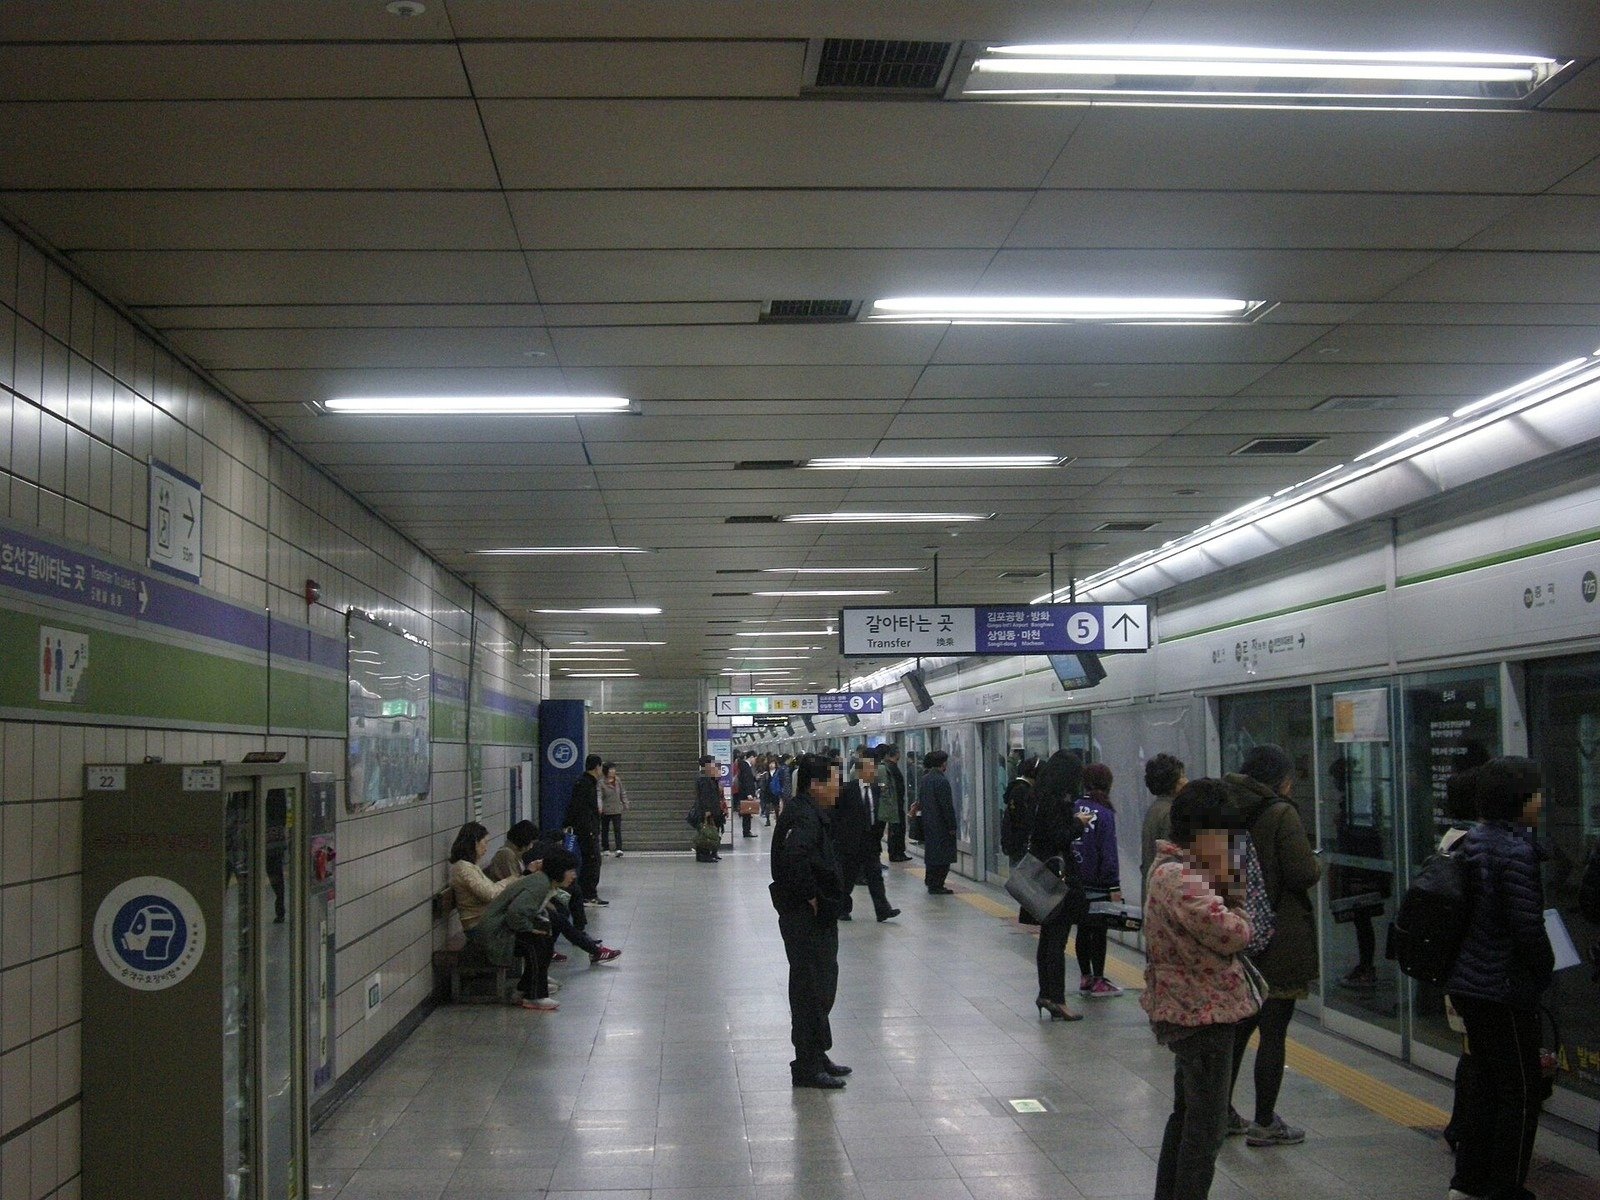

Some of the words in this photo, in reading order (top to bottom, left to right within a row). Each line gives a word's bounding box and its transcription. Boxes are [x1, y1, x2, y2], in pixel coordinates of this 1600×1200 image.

[73, 564, 86, 591] 곳
[866, 615, 932, 633] 갈아타는
[937, 615, 954, 632] 곳
[1077, 618, 1090, 639] 5
[867, 638, 912, 649] Transfer
[100, 776, 115, 788] 22
